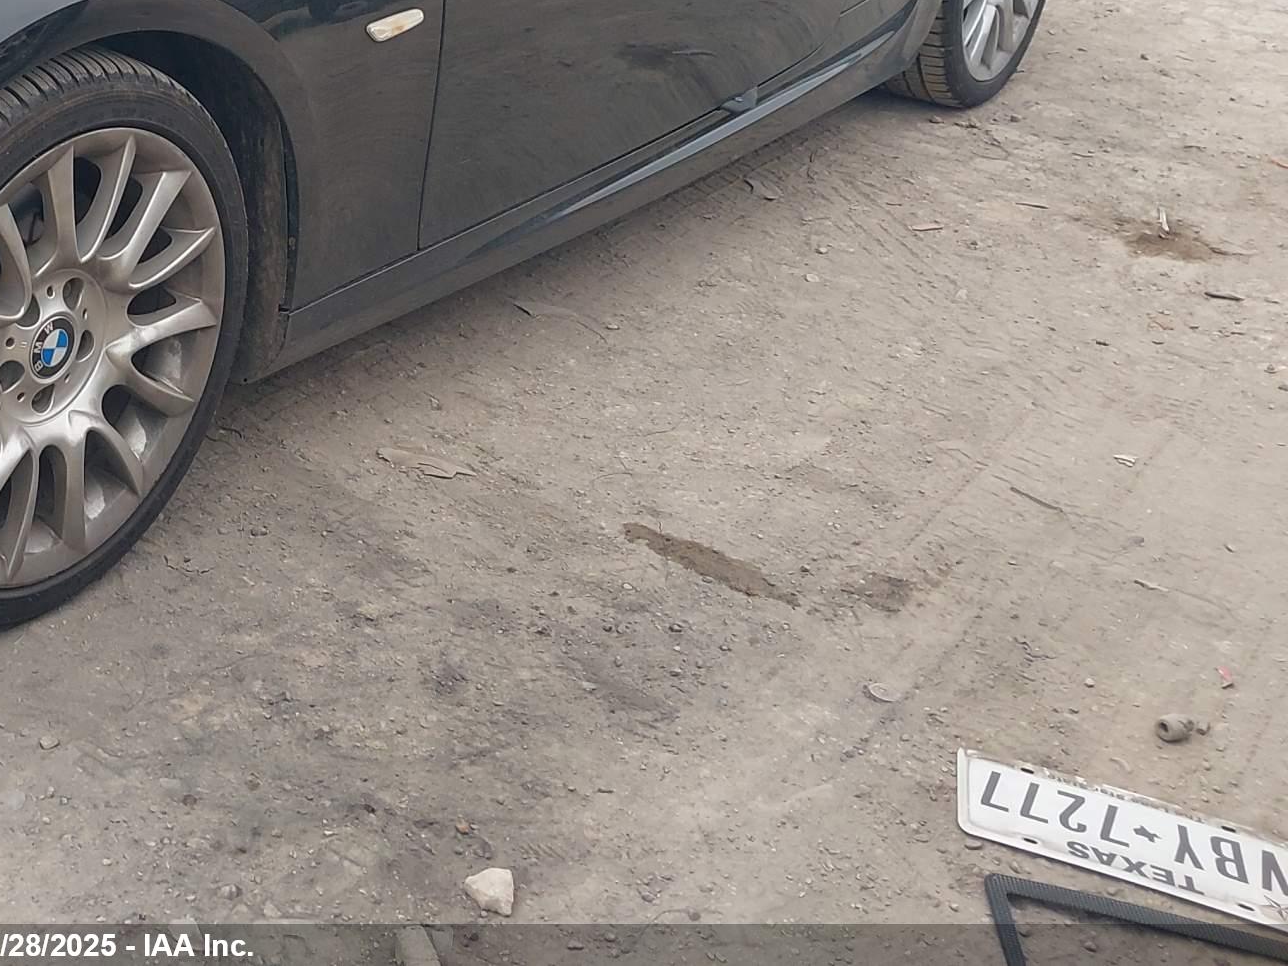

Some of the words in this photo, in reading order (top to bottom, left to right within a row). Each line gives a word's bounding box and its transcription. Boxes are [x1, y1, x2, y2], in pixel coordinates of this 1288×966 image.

[33, 321, 55, 372] BMW
[980, 771, 1130, 848] 7277
[1066, 841, 1205, 895] TEXAS
